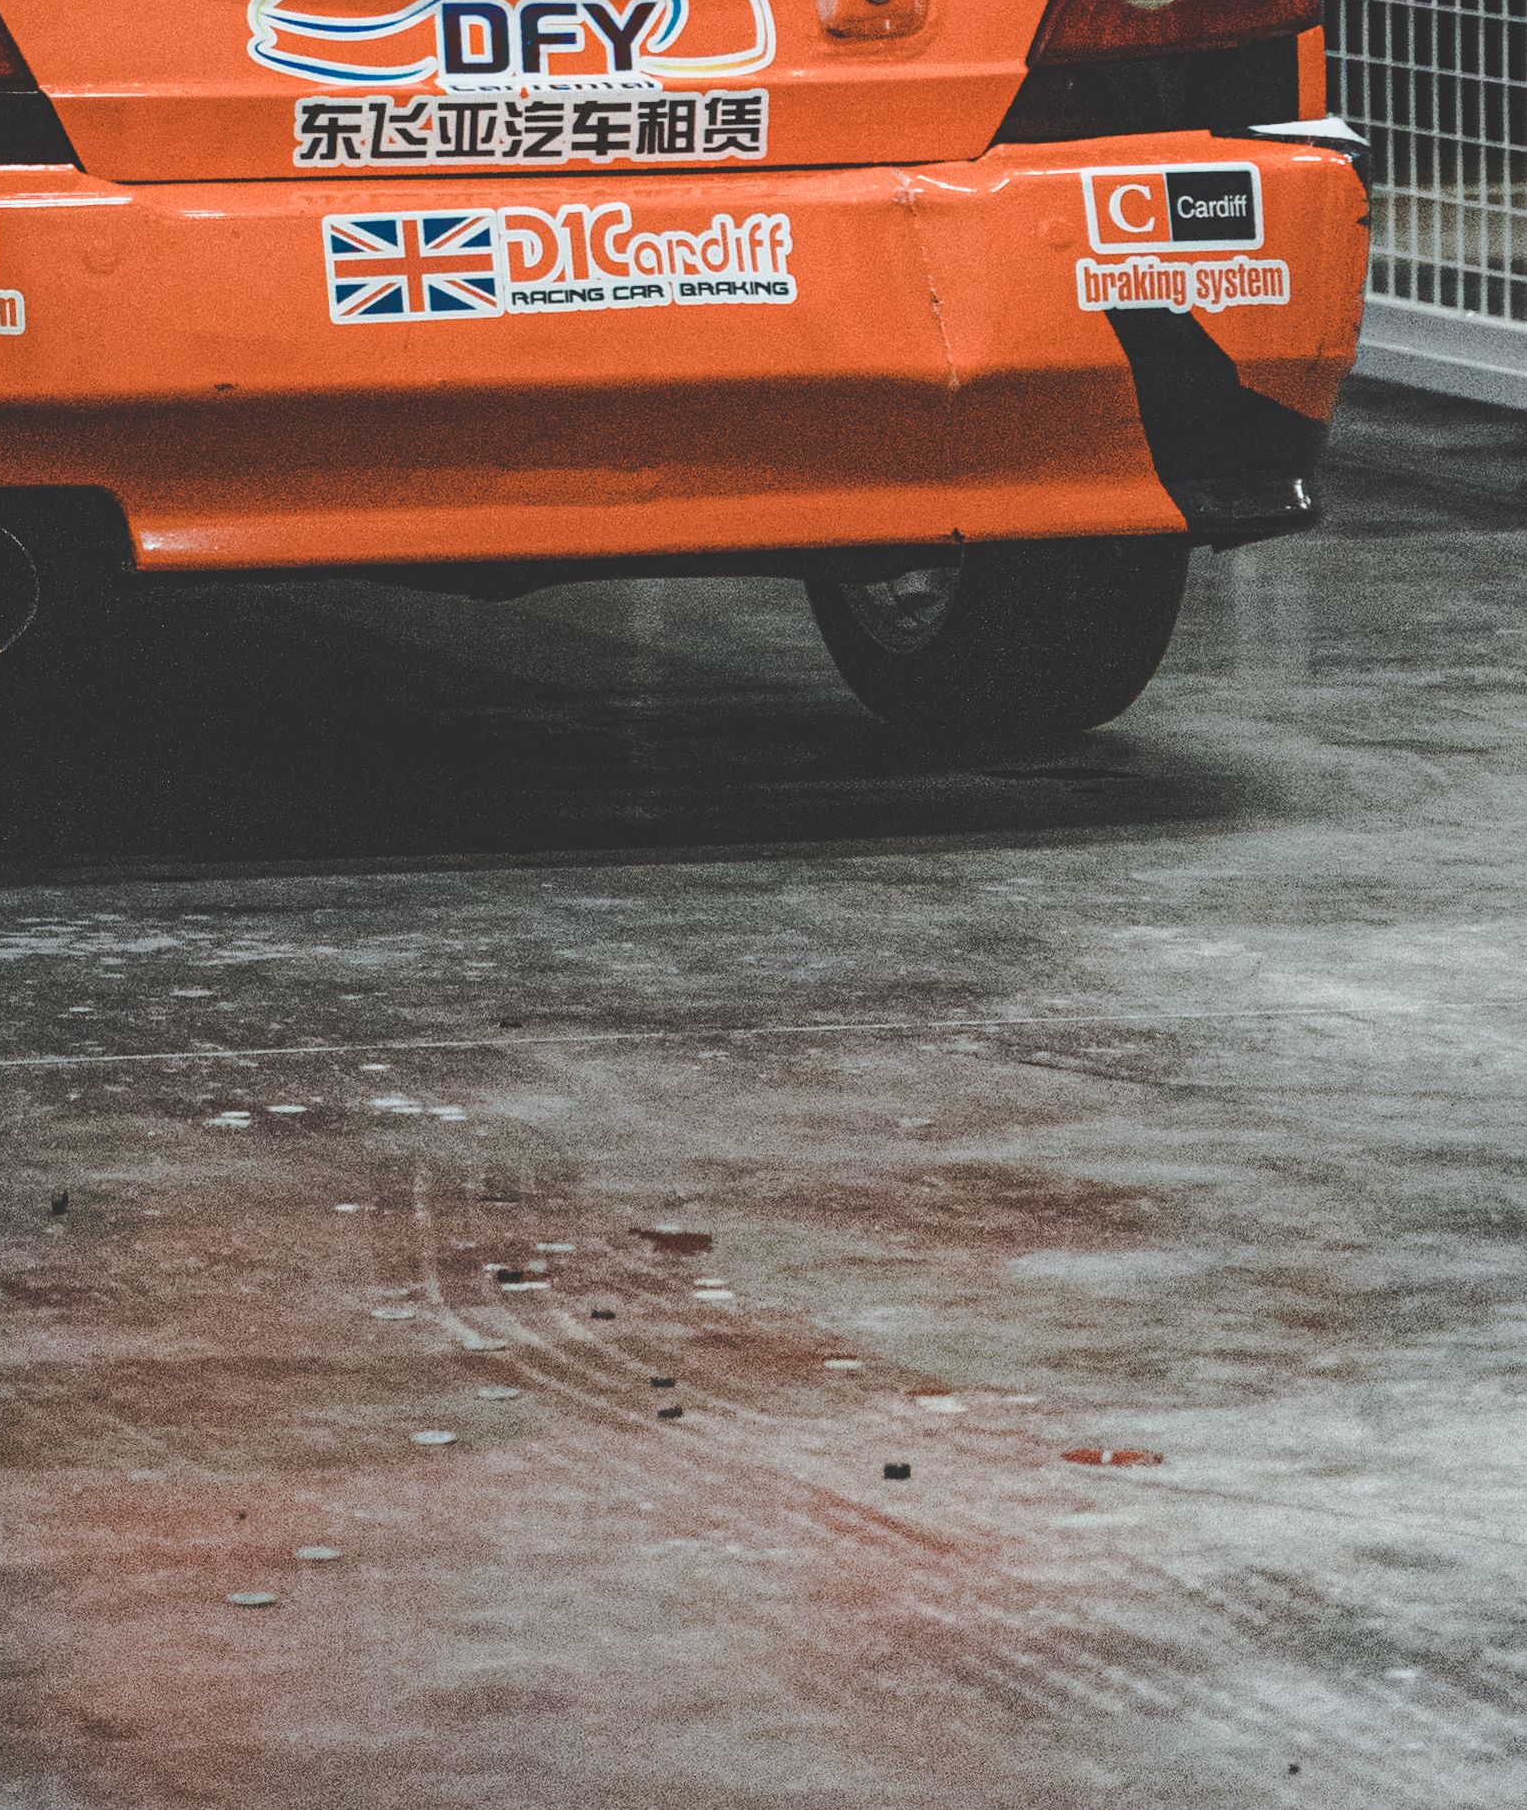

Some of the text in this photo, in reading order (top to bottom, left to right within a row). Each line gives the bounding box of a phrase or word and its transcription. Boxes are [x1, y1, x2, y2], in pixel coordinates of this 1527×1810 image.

[442, 2, 657, 74] DFY
[299, 95, 763, 162] 东飞亚汽车租赁
[1176, 195, 1248, 219] Cardiff
[511, 281, 790, 305] RACING CAR BRAKING
[1083, 262, 1285, 306] braking system
